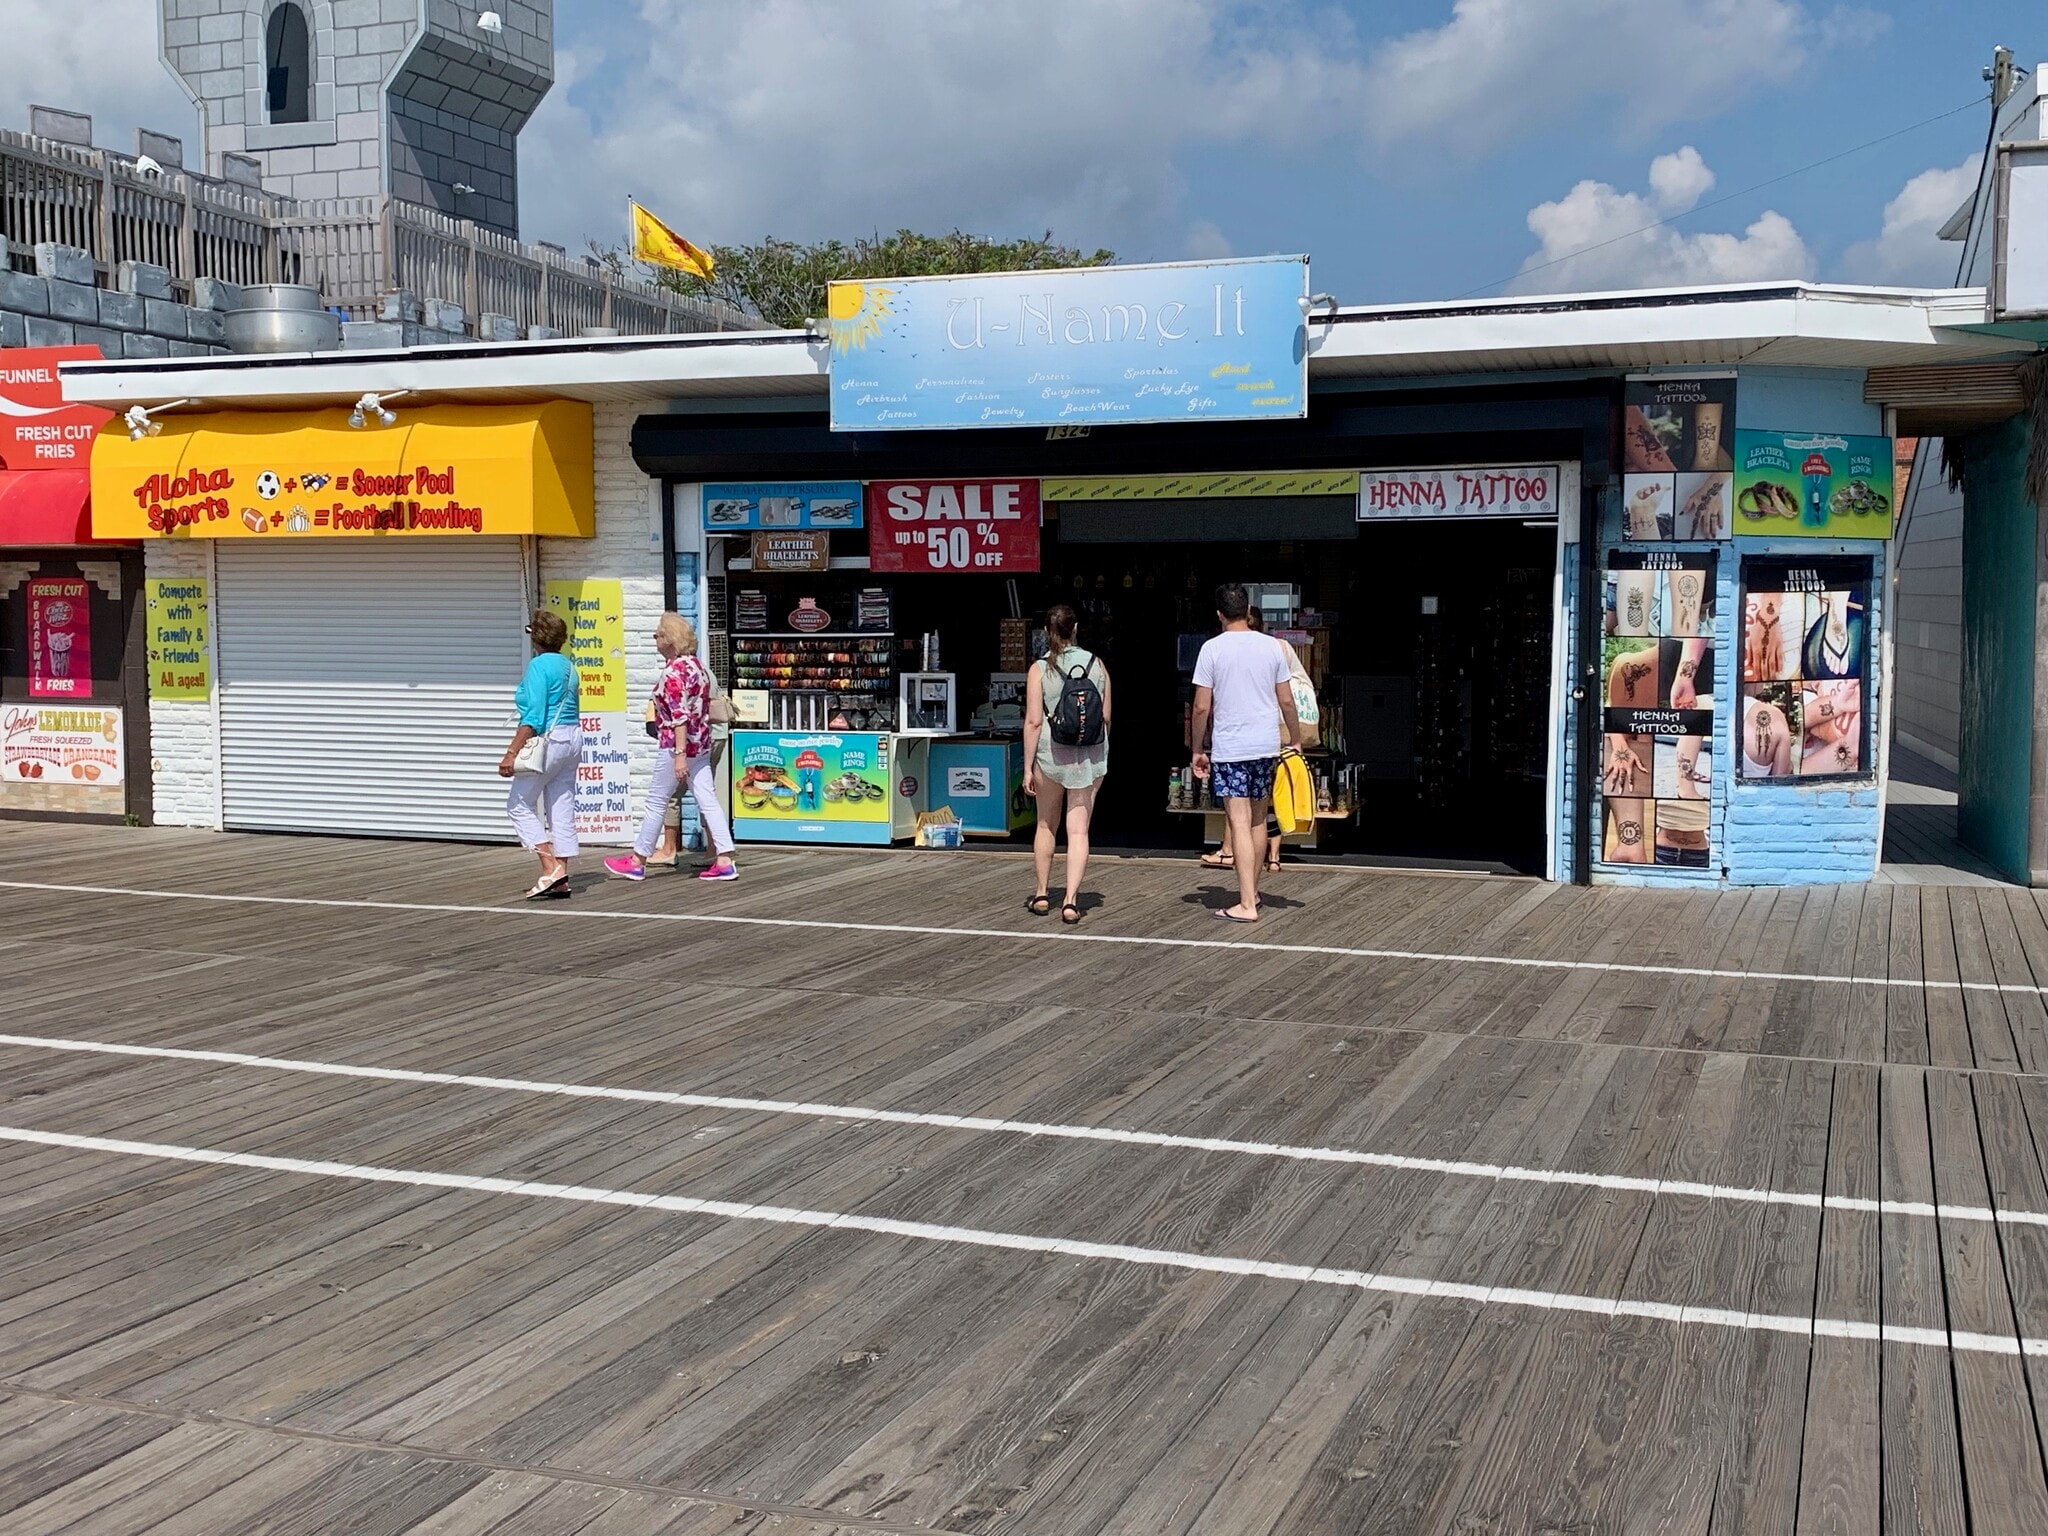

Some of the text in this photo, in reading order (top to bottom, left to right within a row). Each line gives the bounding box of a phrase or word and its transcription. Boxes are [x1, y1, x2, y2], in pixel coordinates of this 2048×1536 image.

[946, 283, 1249, 351] U-Name It
[0, 368, 54, 384] FUNNEL
[1027, 372, 1072, 385] Posters
[841, 378, 880, 391] Henna
[1135, 382, 1200, 398] Lucky Eye
[1658, 382, 1701, 392] HENNA
[955, 392, 1001, 404] Fashion
[1041, 386, 1102, 399] Sunglasses
[1655, 393, 1707, 404] TATTOOS
[856, 394, 909, 406] Airbrush
[1186, 398, 1218, 412] Gifts
[877, 409, 918, 422] Tattoos
[981, 406, 1026, 421] Jewelry
[16, 425, 93, 441] FRESH CUT
[1050, 425, 1089, 439] 1324
[35, 443, 76, 459] FRIES
[1750, 447, 1785, 458] LEATHER
[1747, 456, 1791, 470] BRACELETS
[1851, 456, 1872, 466] NAME
[133, 467, 235, 508] Aloha
[352, 466, 455, 497] Soccer Pool
[1369, 473, 1548, 510] HENNA TATTOO
[887, 484, 1021, 522] SALE
[147, 496, 231, 535] Sports
[332, 502, 483, 533] Football Bowling
[768, 540, 813, 549] LEATHER
[896, 522, 1000, 569] up to 50 %
[763, 551, 819, 560] BRACELETS
[975, 552, 1003, 567] OFF
[1647, 552, 1677, 561] HENNA
[1641, 561, 1683, 570] TATTOOS
[1788, 569, 1818, 580] HENNA
[32, 585, 84, 596] FRESH CUT
[158, 583, 202, 602] Compete
[1783, 580, 1826, 591] TATTOOS
[567, 597, 600, 611] Brand
[167, 603, 192, 620] with
[573, 616, 597, 630] New
[157, 626, 204, 645] Family &
[569, 634, 603, 651] Sports
[33, 600, 42, 691] BOARDWALK
[163, 648, 199, 664] Friends
[161, 671, 206, 689] All ages!!
[581, 671, 612, 682] have to
[47, 679, 74, 691] FRIES
[38, 710, 102, 732] LEMONADE
[1632, 711, 1680, 722] HENNA
[579, 717, 601, 732] REE
[1629, 723, 1688, 733] TATTOOS
[30, 735, 93, 745] FRESH SQUEEZED
[601, 732, 611, 746] of
[592, 749, 628, 764] Bowling
[747, 746, 779, 755] LEATHER
[843, 751, 865, 760] NAME
[63, 748, 117, 770] ORANGEADE
[744, 754, 784, 765] BRACELETS
[843, 759, 865, 768] RINGS
[578, 766, 604, 781] FREE
[586, 783, 604, 795] and
[607, 781, 629, 794] Shot
[574, 798, 625, 813] Soccer Pool
[602, 814, 623, 823] players
[590, 824, 603, 833] Soft
